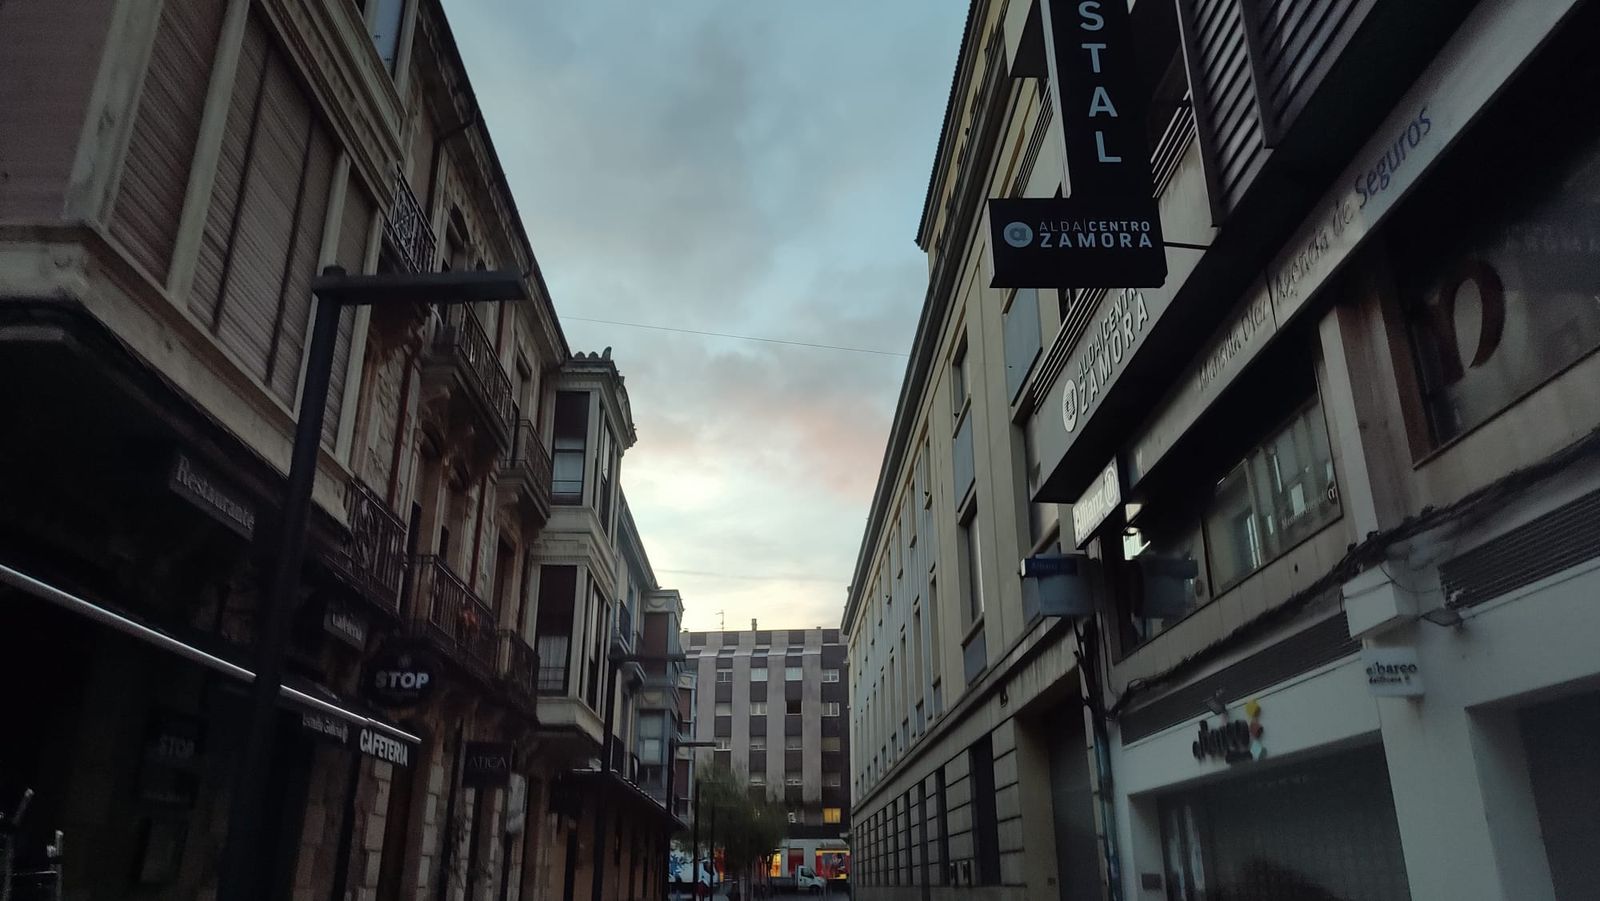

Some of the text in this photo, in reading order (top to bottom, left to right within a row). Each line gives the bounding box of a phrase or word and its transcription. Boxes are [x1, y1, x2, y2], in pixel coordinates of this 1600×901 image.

[1333, 200, 1354, 237] de
[1355, 107, 1431, 210] Seguros
[1040, 233, 1152, 248] ZAMORA
[1088, 221, 1150, 232] CENTRO
[1080, 292, 1149, 416] ZAMORA
[375, 671, 430, 689] STOP
[360, 728, 409, 767] CAFETERIA
